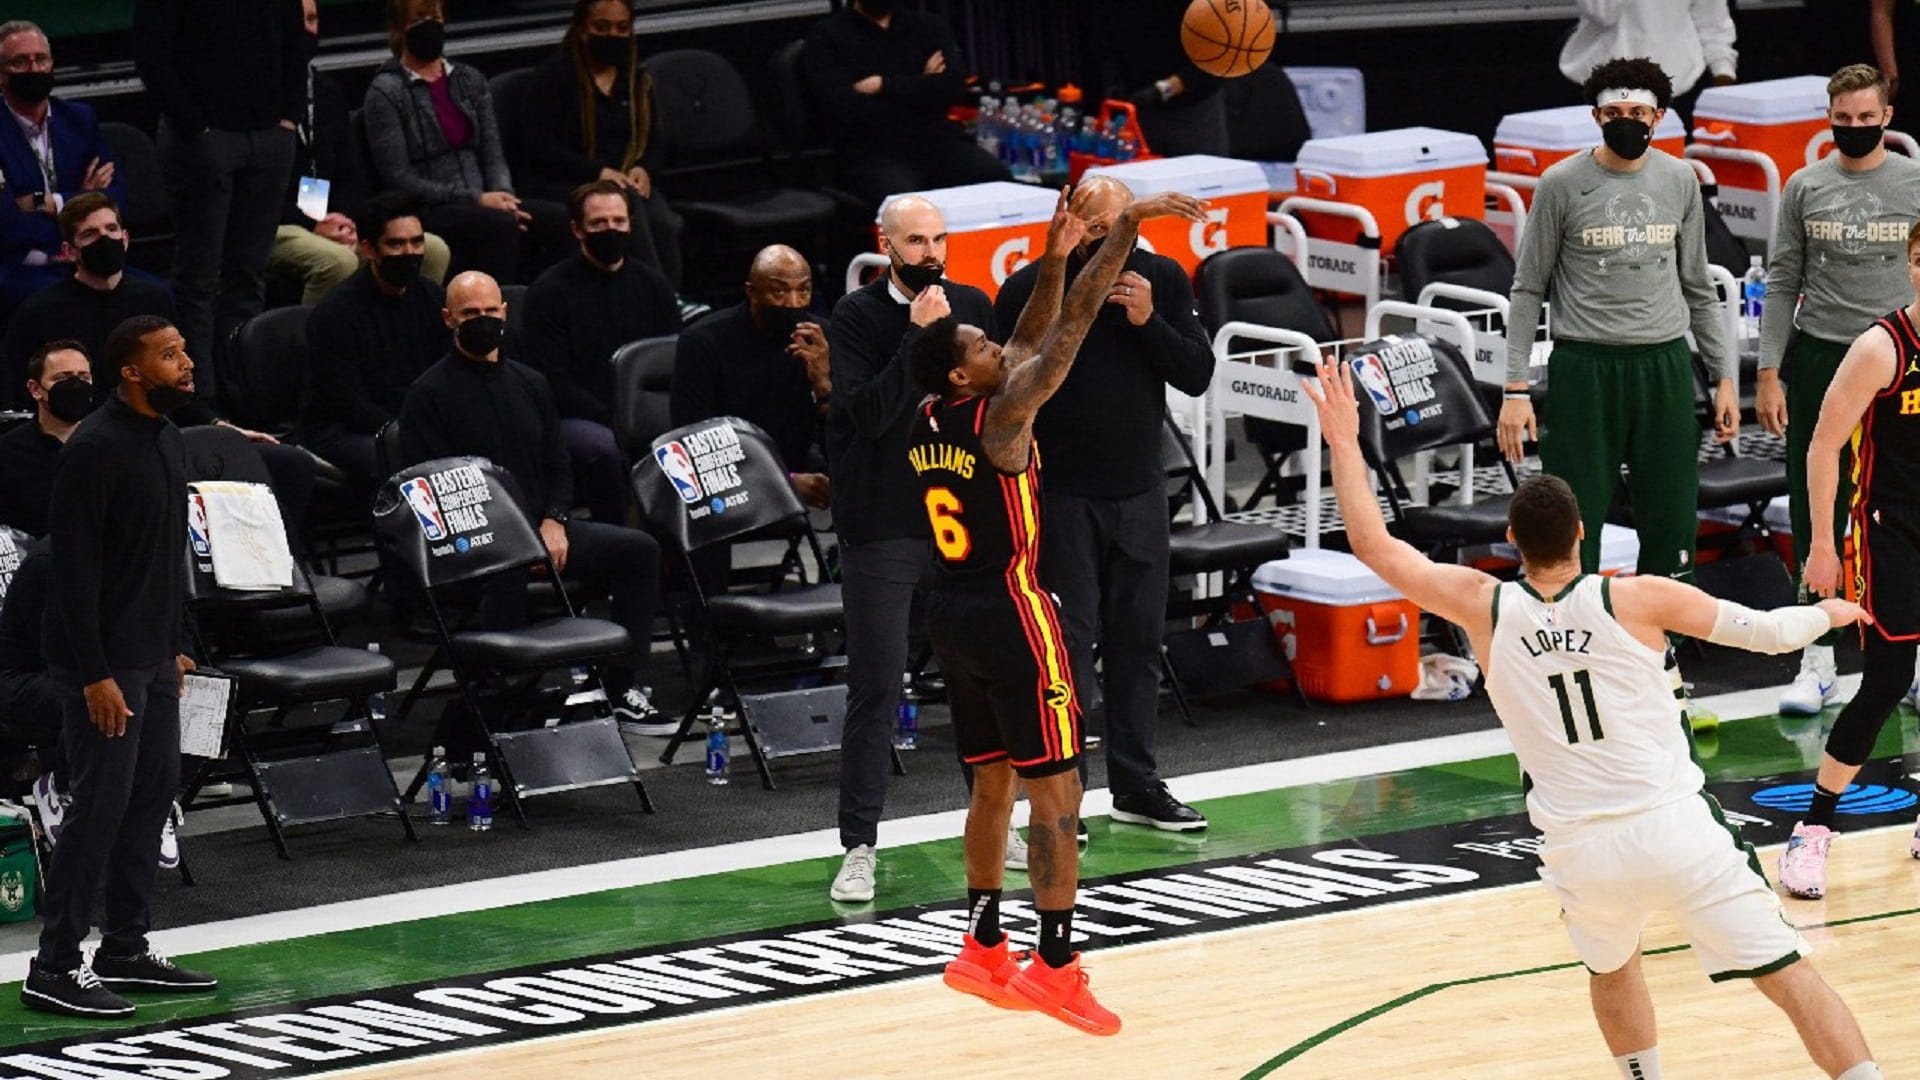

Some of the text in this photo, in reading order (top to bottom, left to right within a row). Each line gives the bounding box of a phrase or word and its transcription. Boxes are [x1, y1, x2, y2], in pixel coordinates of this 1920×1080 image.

[1582, 225, 1625, 247] FEAR
[1866, 221, 1909, 241] DEER
[1231, 379, 1298, 404] GATORADE
[682, 423, 741, 458] EASTERN
[430, 463, 487, 496] EASTERN
[699, 463, 743, 497] FINALS
[444, 503, 489, 535] FINALS
[924, 486, 972, 563] 6
[469, 531, 495, 548] AT&T
[1520, 629, 1593, 658] LOPEZ
[1547, 668, 1605, 745] 11
[0, 999, 508, 1080] ASTERN
[1080, 847, 1481, 938] FINALS
